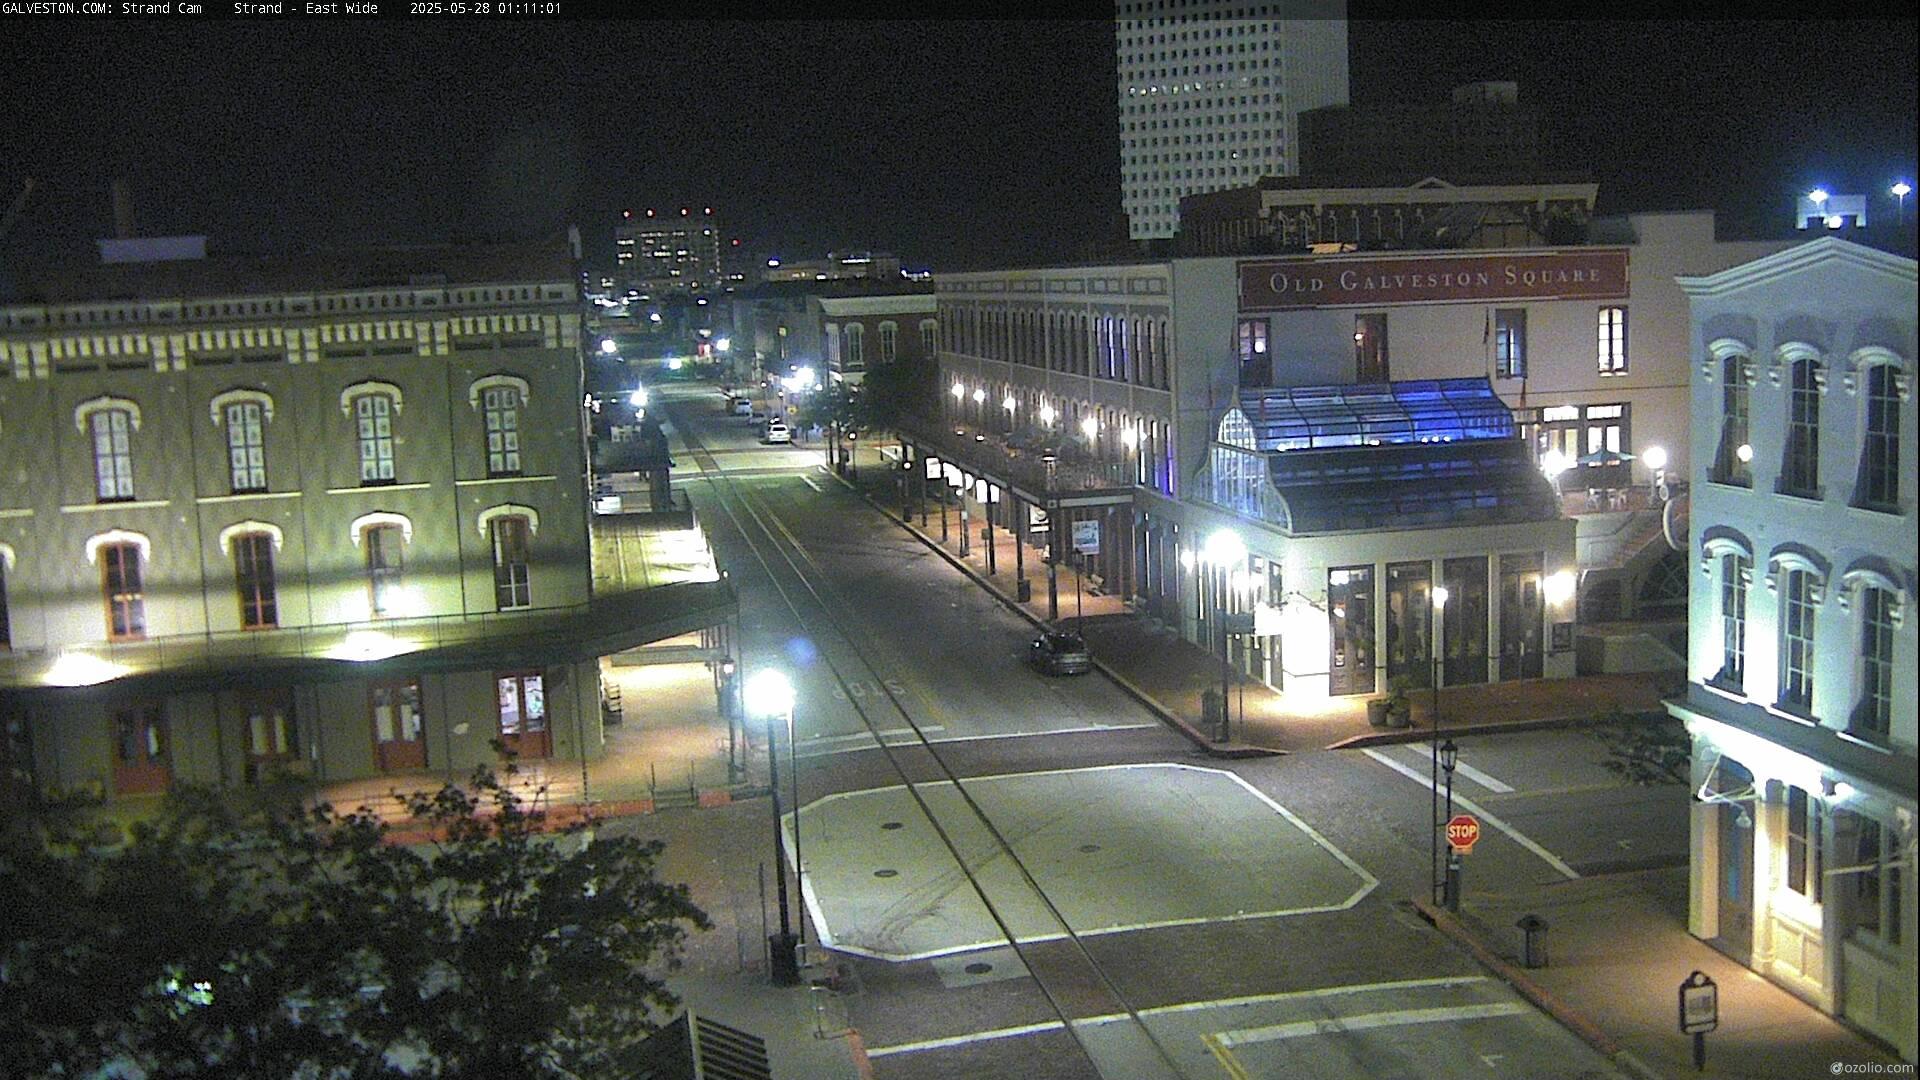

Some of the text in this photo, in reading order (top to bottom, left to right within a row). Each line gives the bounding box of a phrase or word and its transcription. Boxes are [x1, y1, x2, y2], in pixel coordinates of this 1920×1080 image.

[1269, 264, 1600, 293] OLD GALVESTON SQUARE
[1448, 824, 1477, 838] STOP
